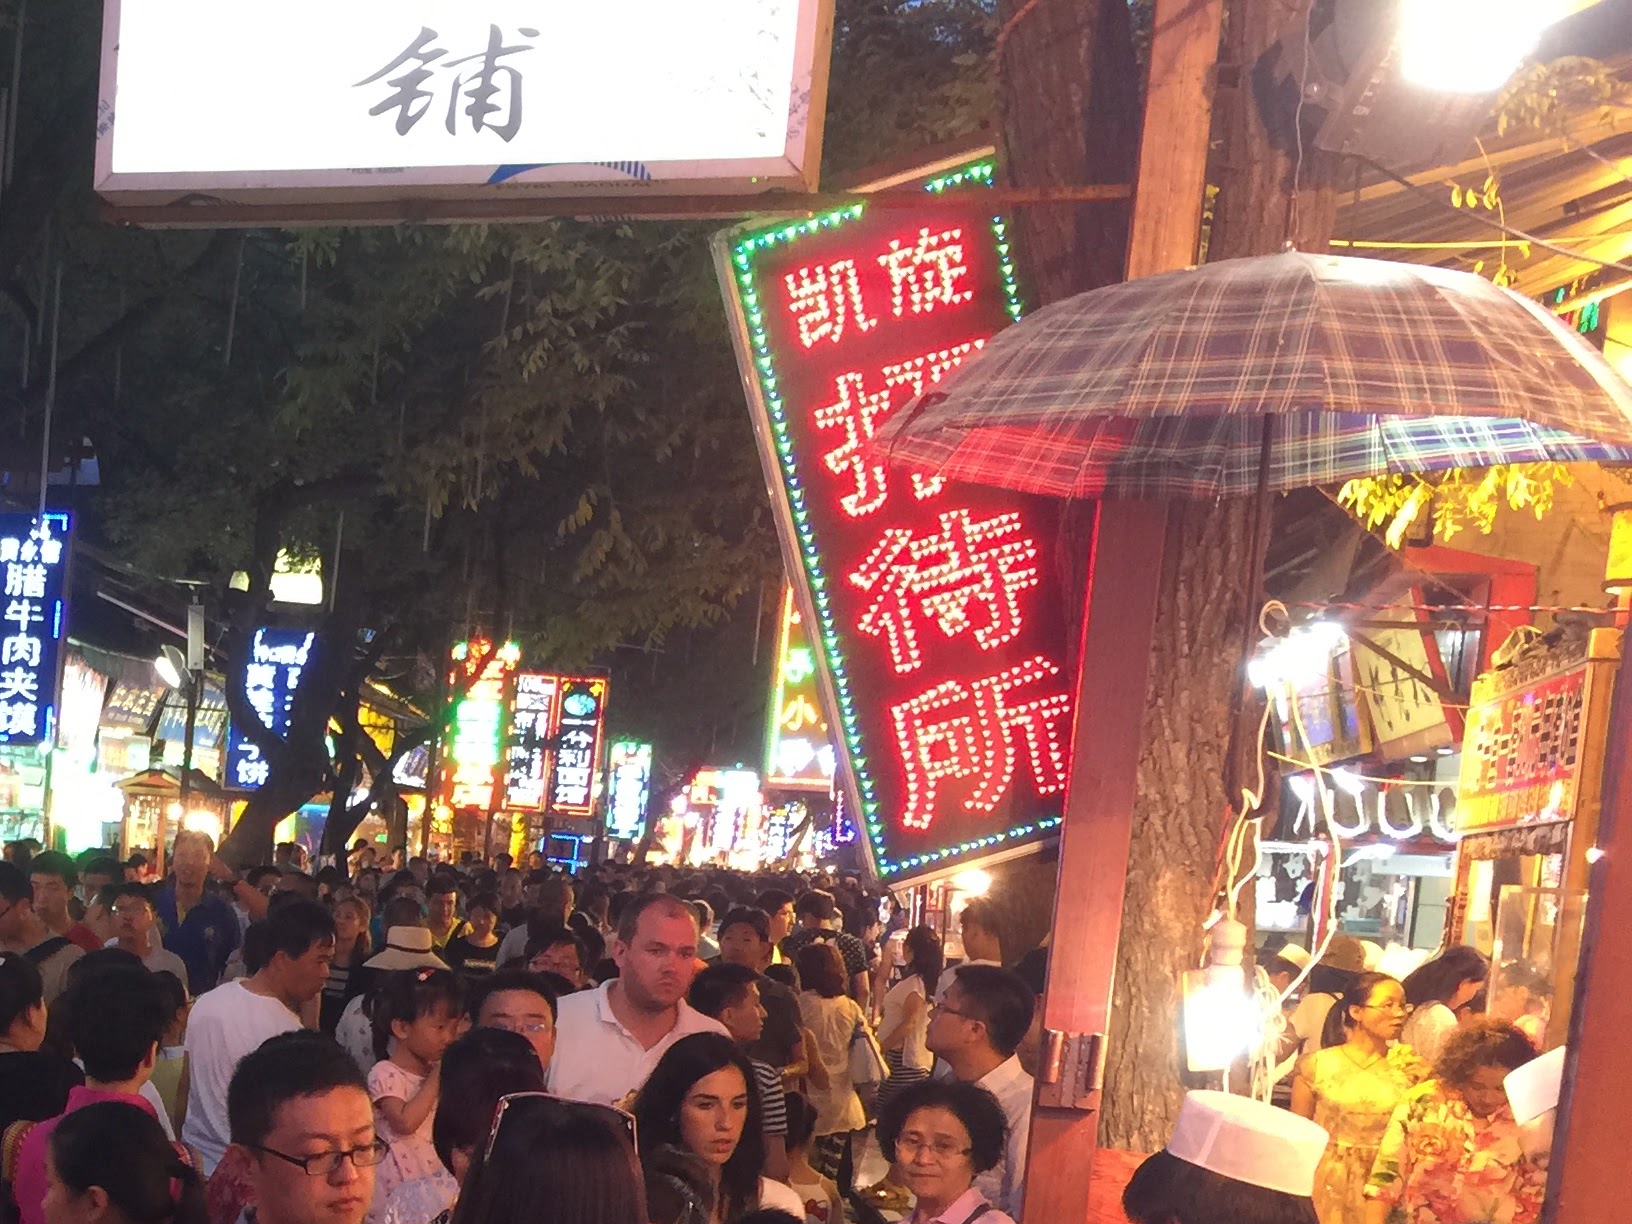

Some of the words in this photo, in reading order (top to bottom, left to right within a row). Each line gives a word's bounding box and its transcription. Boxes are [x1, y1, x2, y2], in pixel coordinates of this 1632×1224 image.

[785, 227, 973, 348] 凯旋
[814, 338, 1070, 830] 招待所
